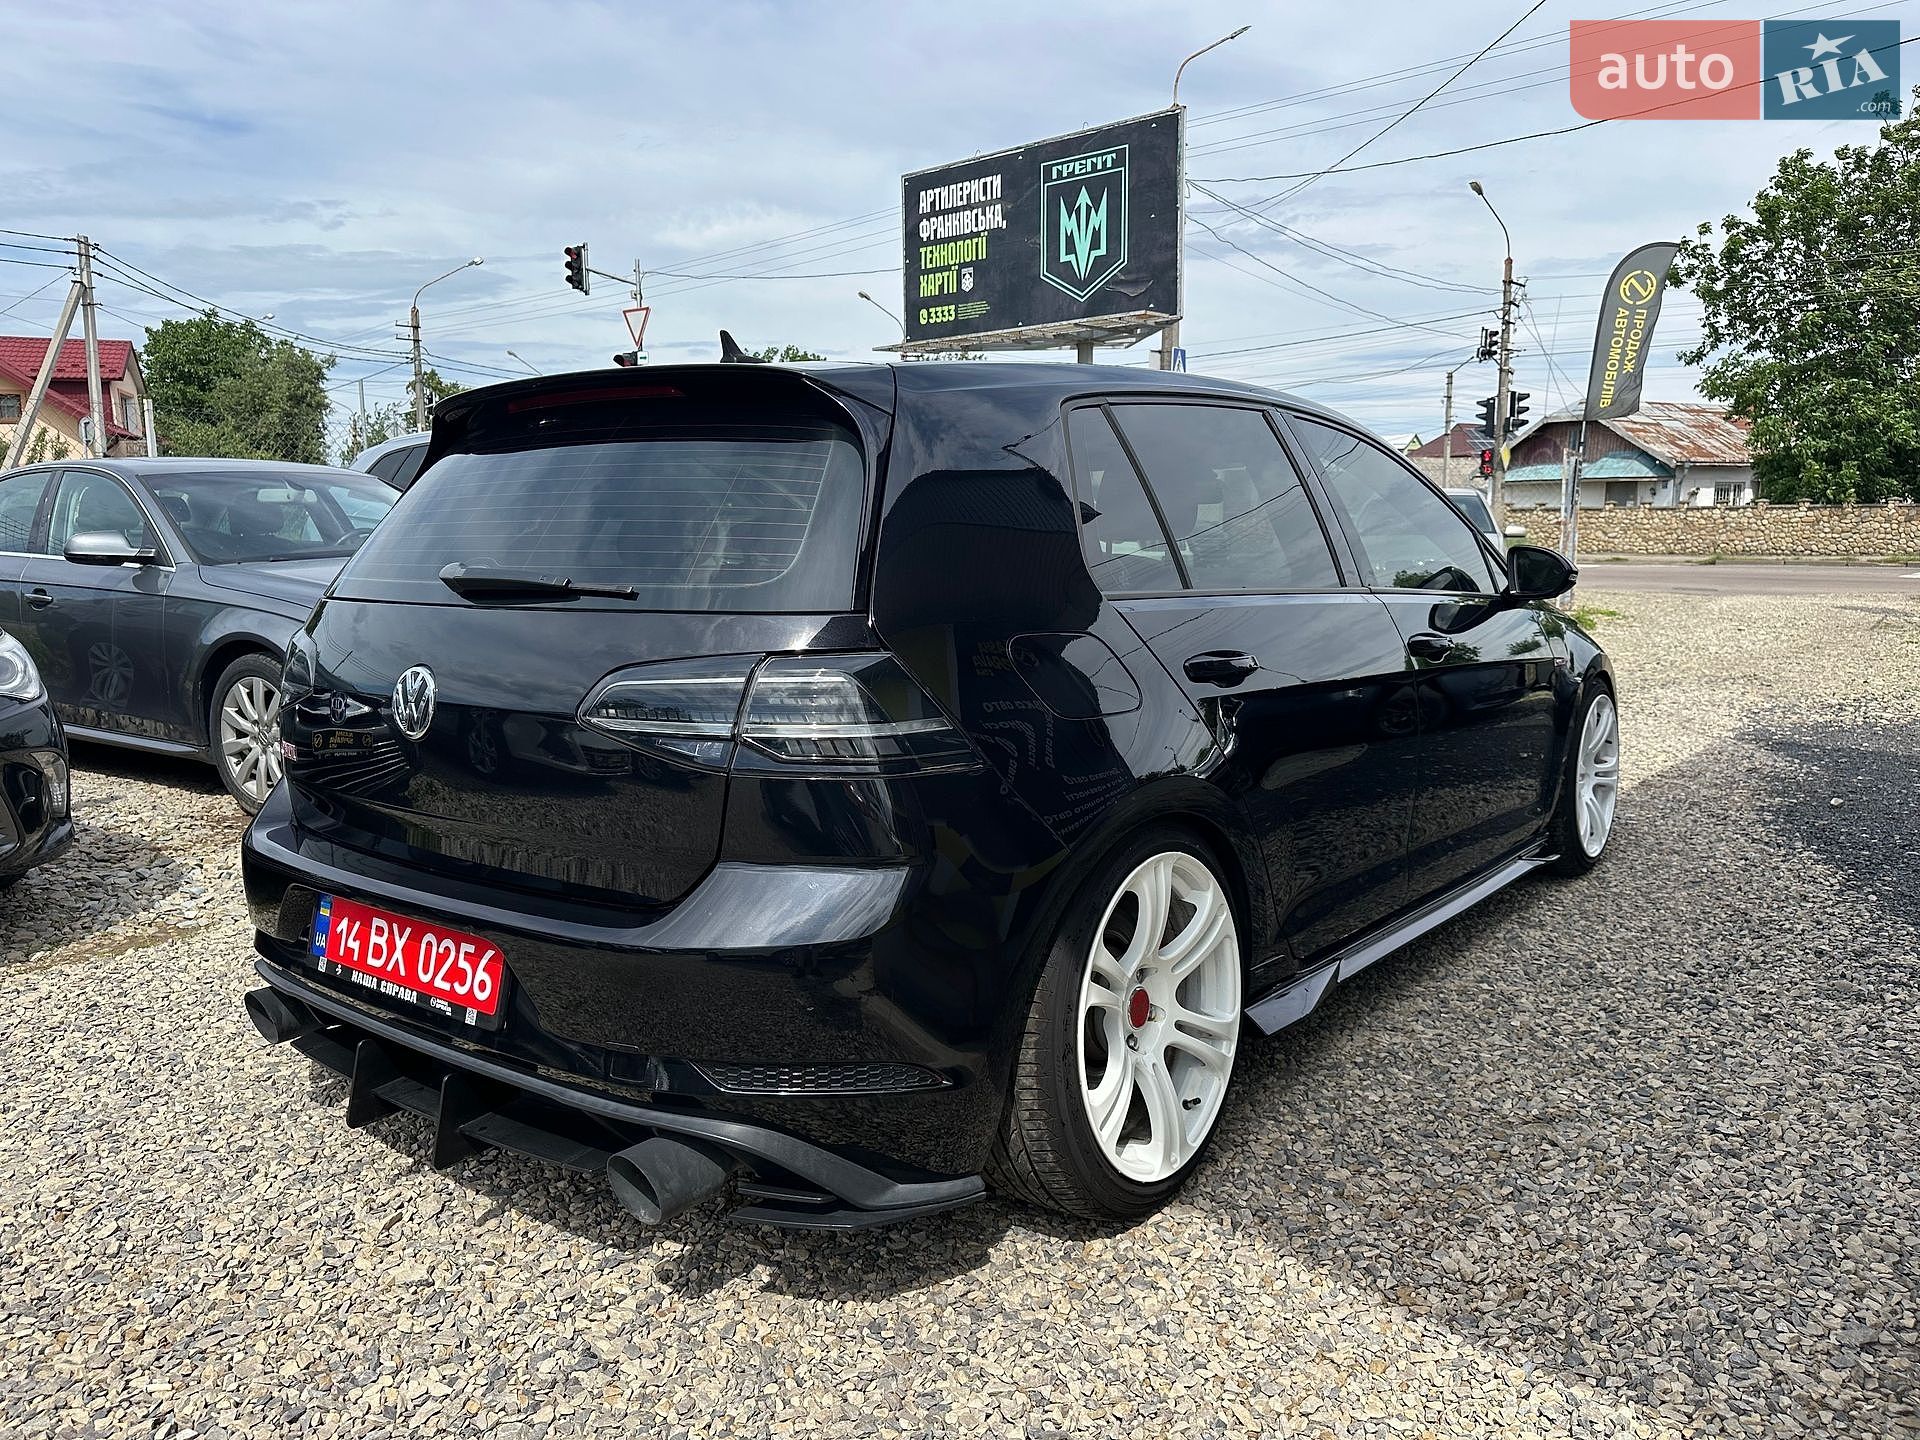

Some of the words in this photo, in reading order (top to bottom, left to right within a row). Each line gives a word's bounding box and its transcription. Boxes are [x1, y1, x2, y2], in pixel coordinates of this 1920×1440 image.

[918, 173, 1002, 215] АРТИЛЕРИСТИ
[918, 203, 1007, 242] ФРАНКІВСЬКА,
[919, 231, 988, 270] ТЕХНОЛОГІЇ
[919, 265, 958, 298] ХАРТІЇ
[928, 304, 956, 324] 3333
[1600, 307, 1630, 409] АВТОМОБІЛІВ
[1622, 308, 1648, 374] ПРОДАЖ
[315, 932, 326, 949] UA
[335, 916, 361, 962] 14
[366, 917, 412, 977] BX
[417, 932, 496, 1001] 0256
[351, 970, 378, 990] НАША
[380, 980, 418, 1004] СПРАВА
